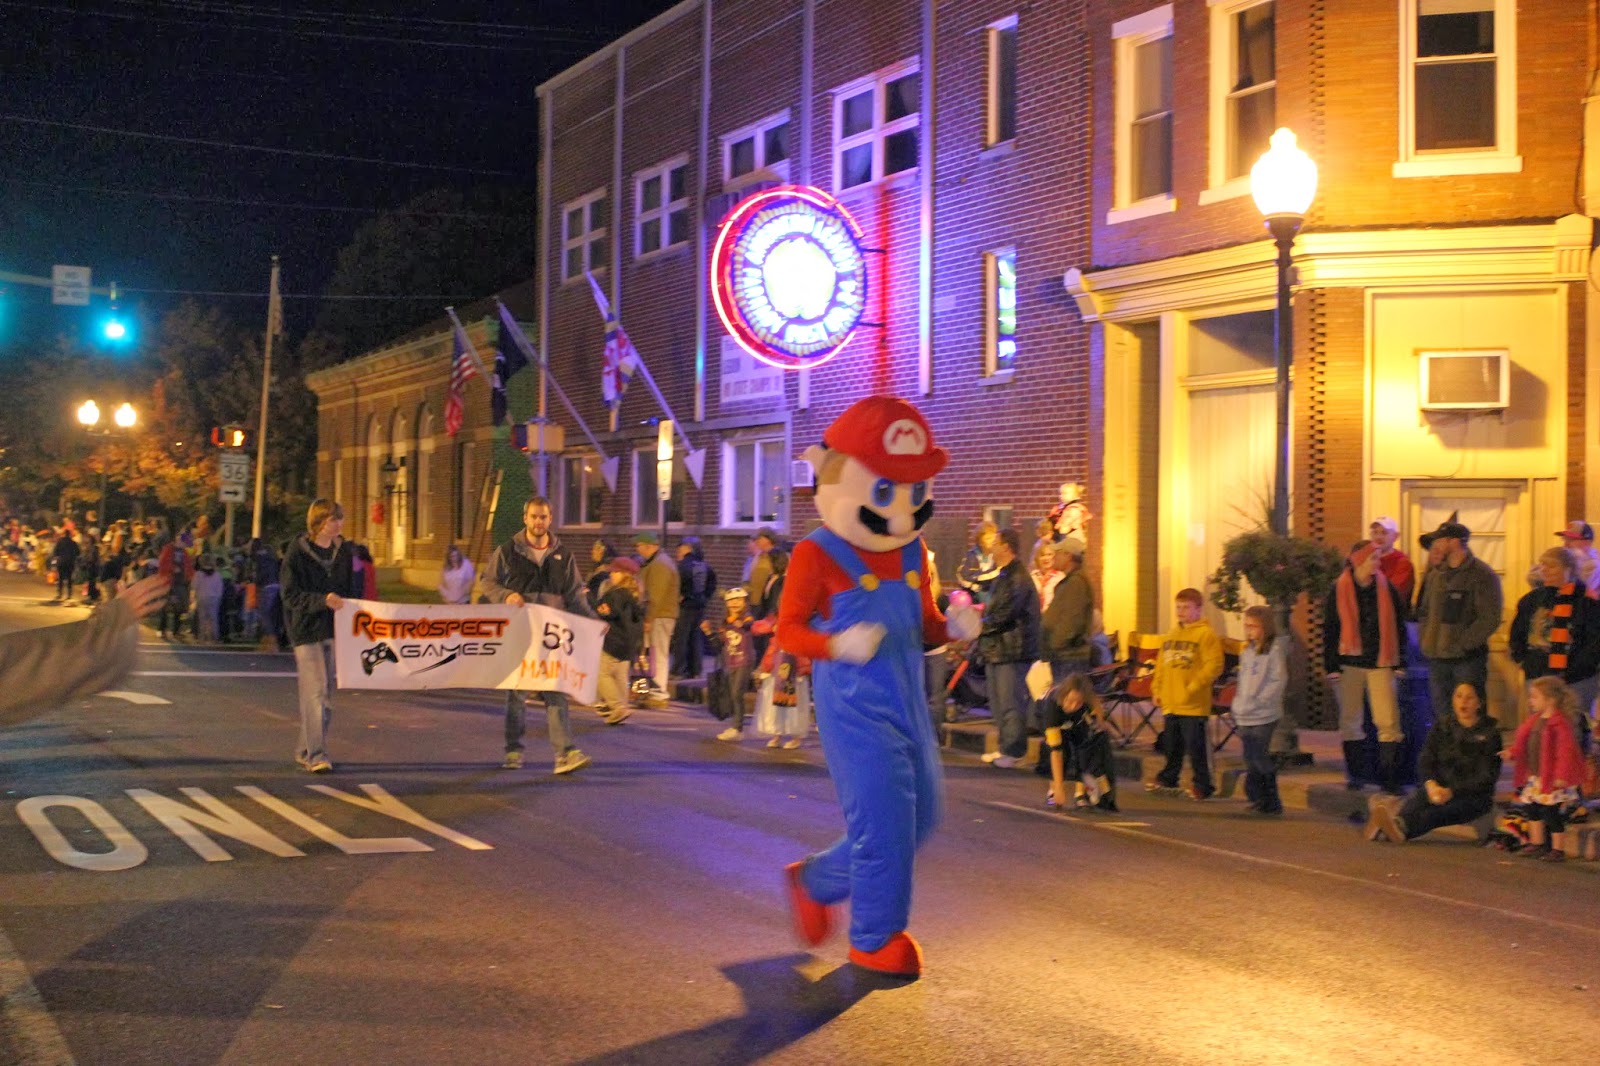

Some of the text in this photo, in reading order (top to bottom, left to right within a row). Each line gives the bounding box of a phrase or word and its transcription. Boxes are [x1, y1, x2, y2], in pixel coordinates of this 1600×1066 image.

[890, 426, 921, 446] M
[223, 464, 246, 480] 36
[542, 622, 575, 656] 53
[401, 642, 502, 658] GAMES
[520, 659, 568, 680] MAIN
[15, 784, 496, 871] ONLY
